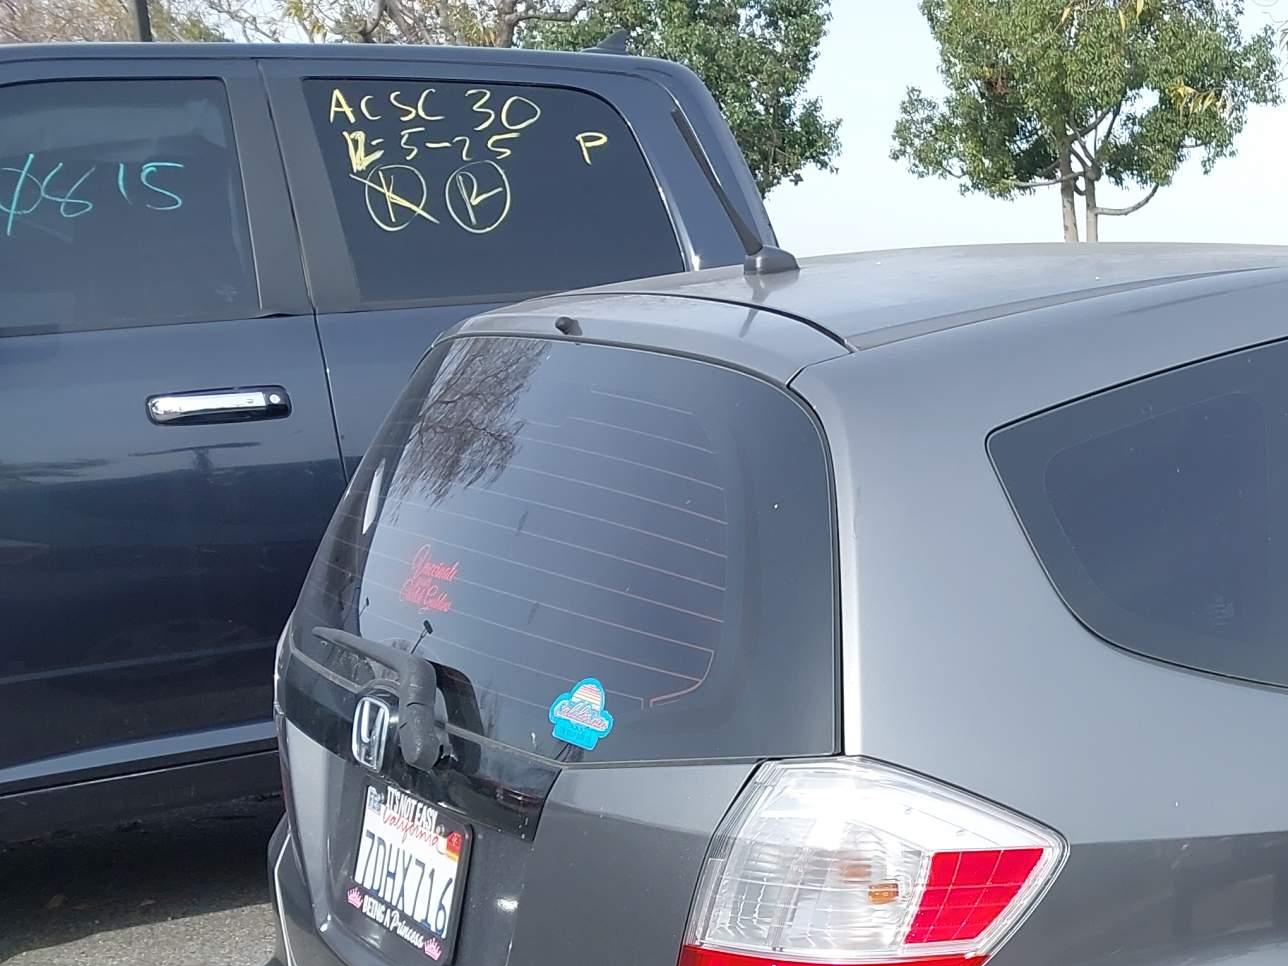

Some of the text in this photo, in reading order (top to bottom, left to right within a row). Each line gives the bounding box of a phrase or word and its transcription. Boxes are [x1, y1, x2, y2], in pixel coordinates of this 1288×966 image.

[465, 89, 541, 131] 30
[576, 132, 608, 166] P
[400, 793, 418, 824] NOT
[416, 802, 438, 834] EASY
[361, 830, 453, 939] 7DHX716
[362, 895, 386, 923] BEING
[389, 910, 425, 949] Princess
